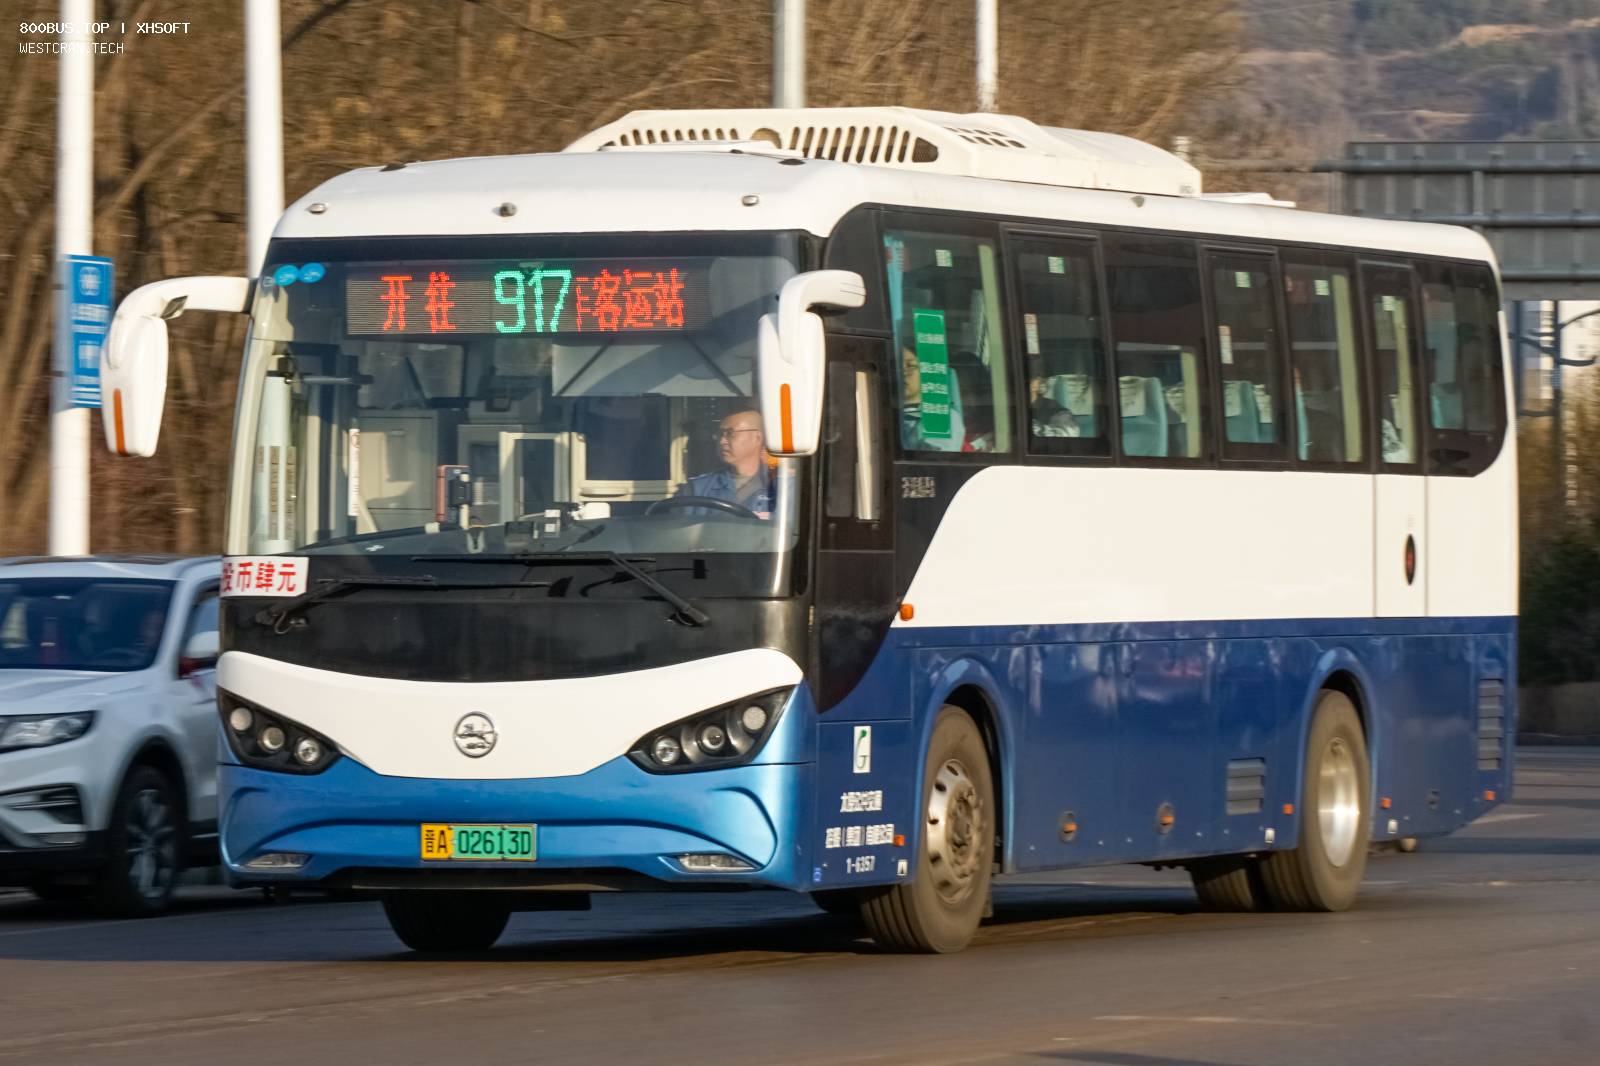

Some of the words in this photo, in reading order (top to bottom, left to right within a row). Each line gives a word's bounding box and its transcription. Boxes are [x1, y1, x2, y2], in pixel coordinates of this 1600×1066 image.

[379, 271, 457, 334] 开往
[494, 269, 572, 334] 917
[458, 830, 532, 855] 02613D
